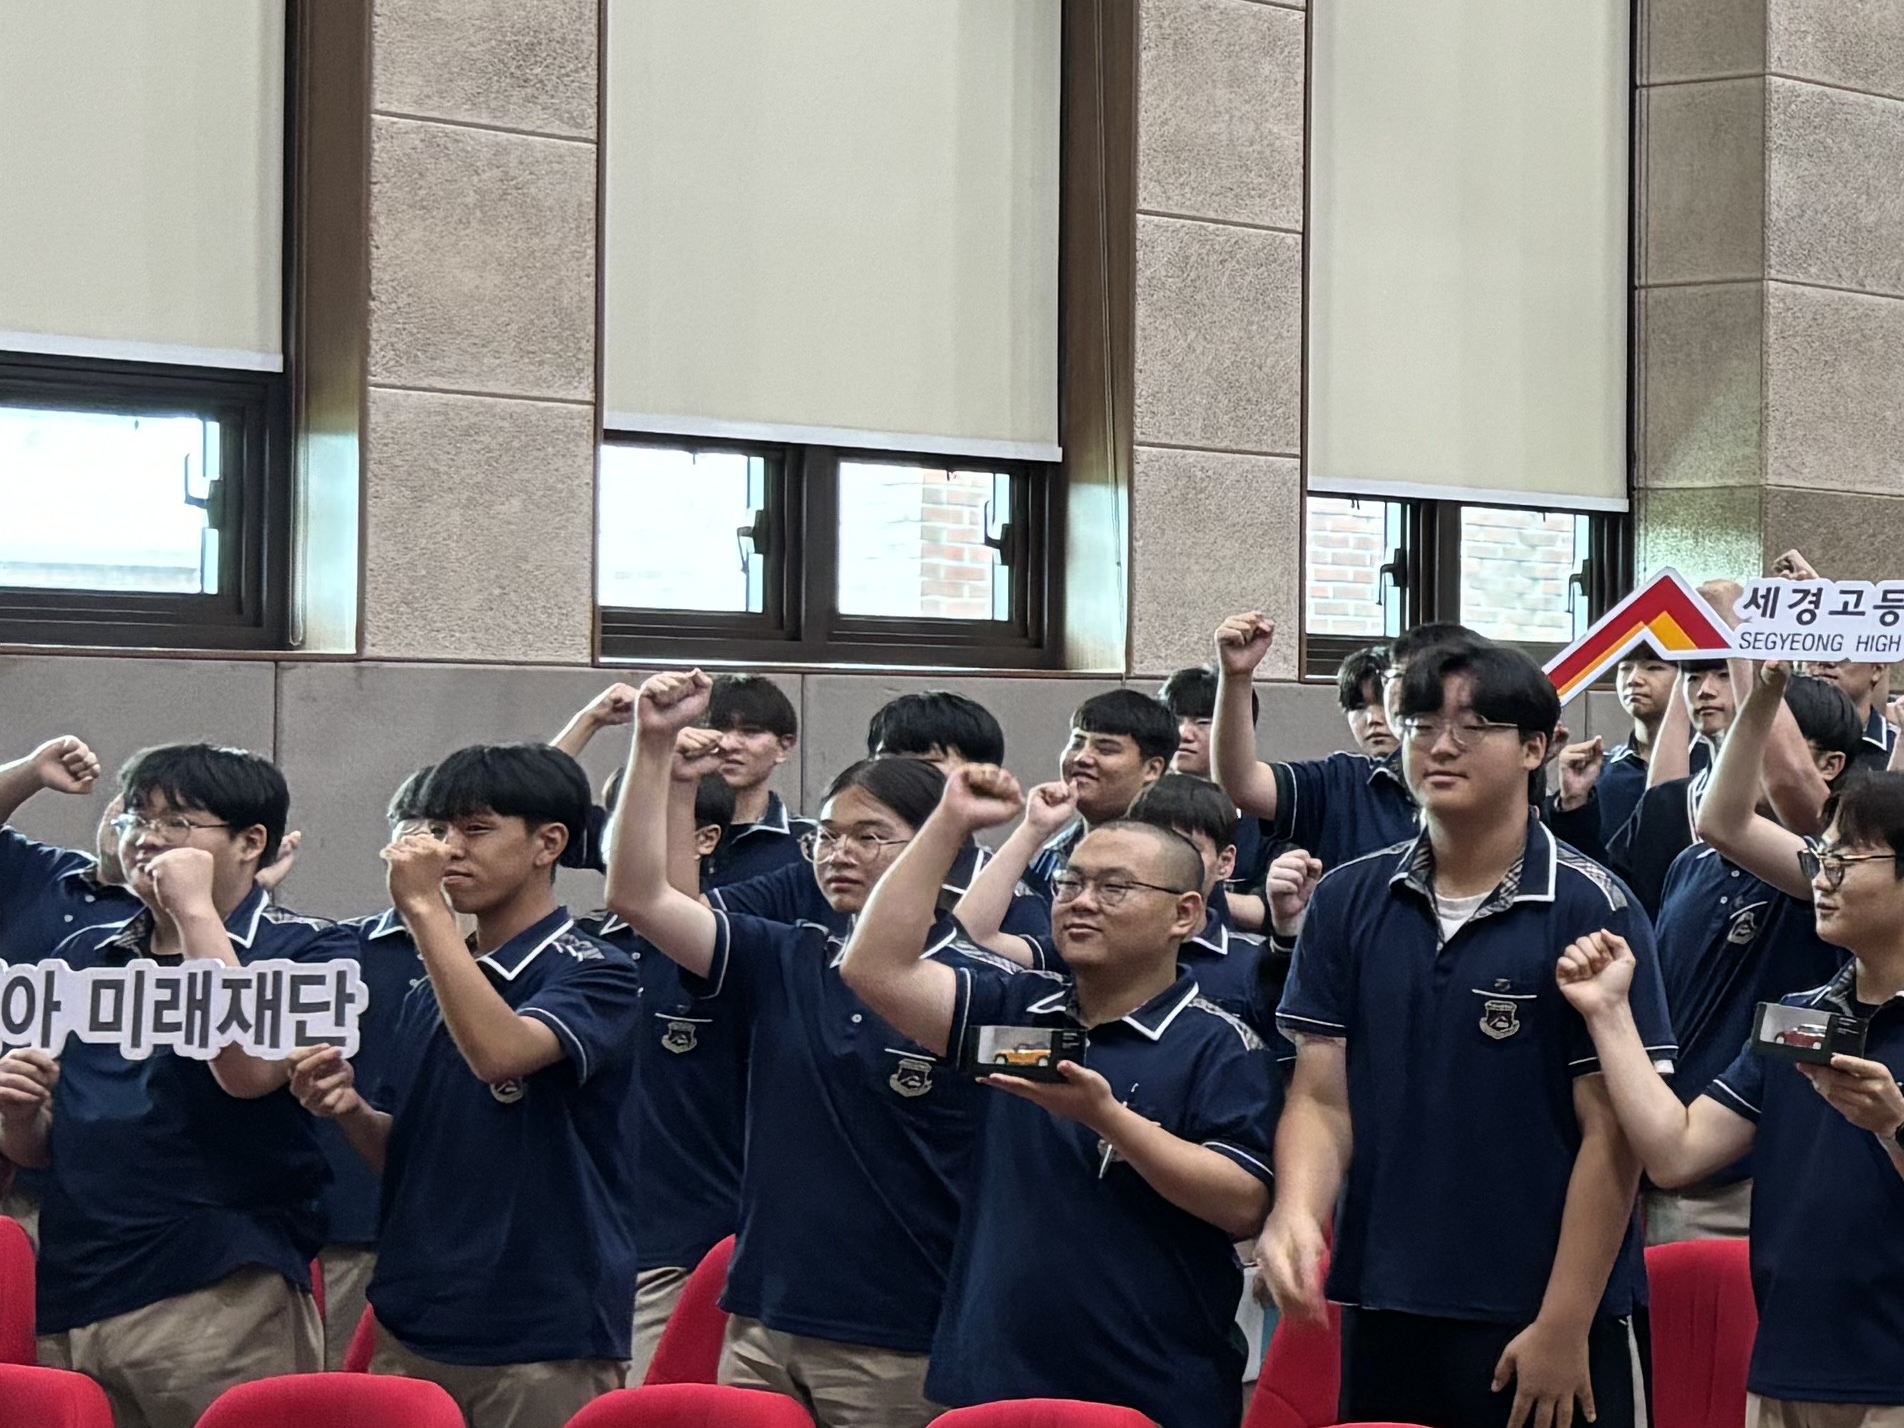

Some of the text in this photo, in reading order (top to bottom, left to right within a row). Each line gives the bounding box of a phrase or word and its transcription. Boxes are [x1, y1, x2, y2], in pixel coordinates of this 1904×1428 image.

[1738, 631, 1844, 653] SEGYEONG
[1855, 633, 1902, 653] HIGH
[89, 969, 356, 1049] 미래재단
